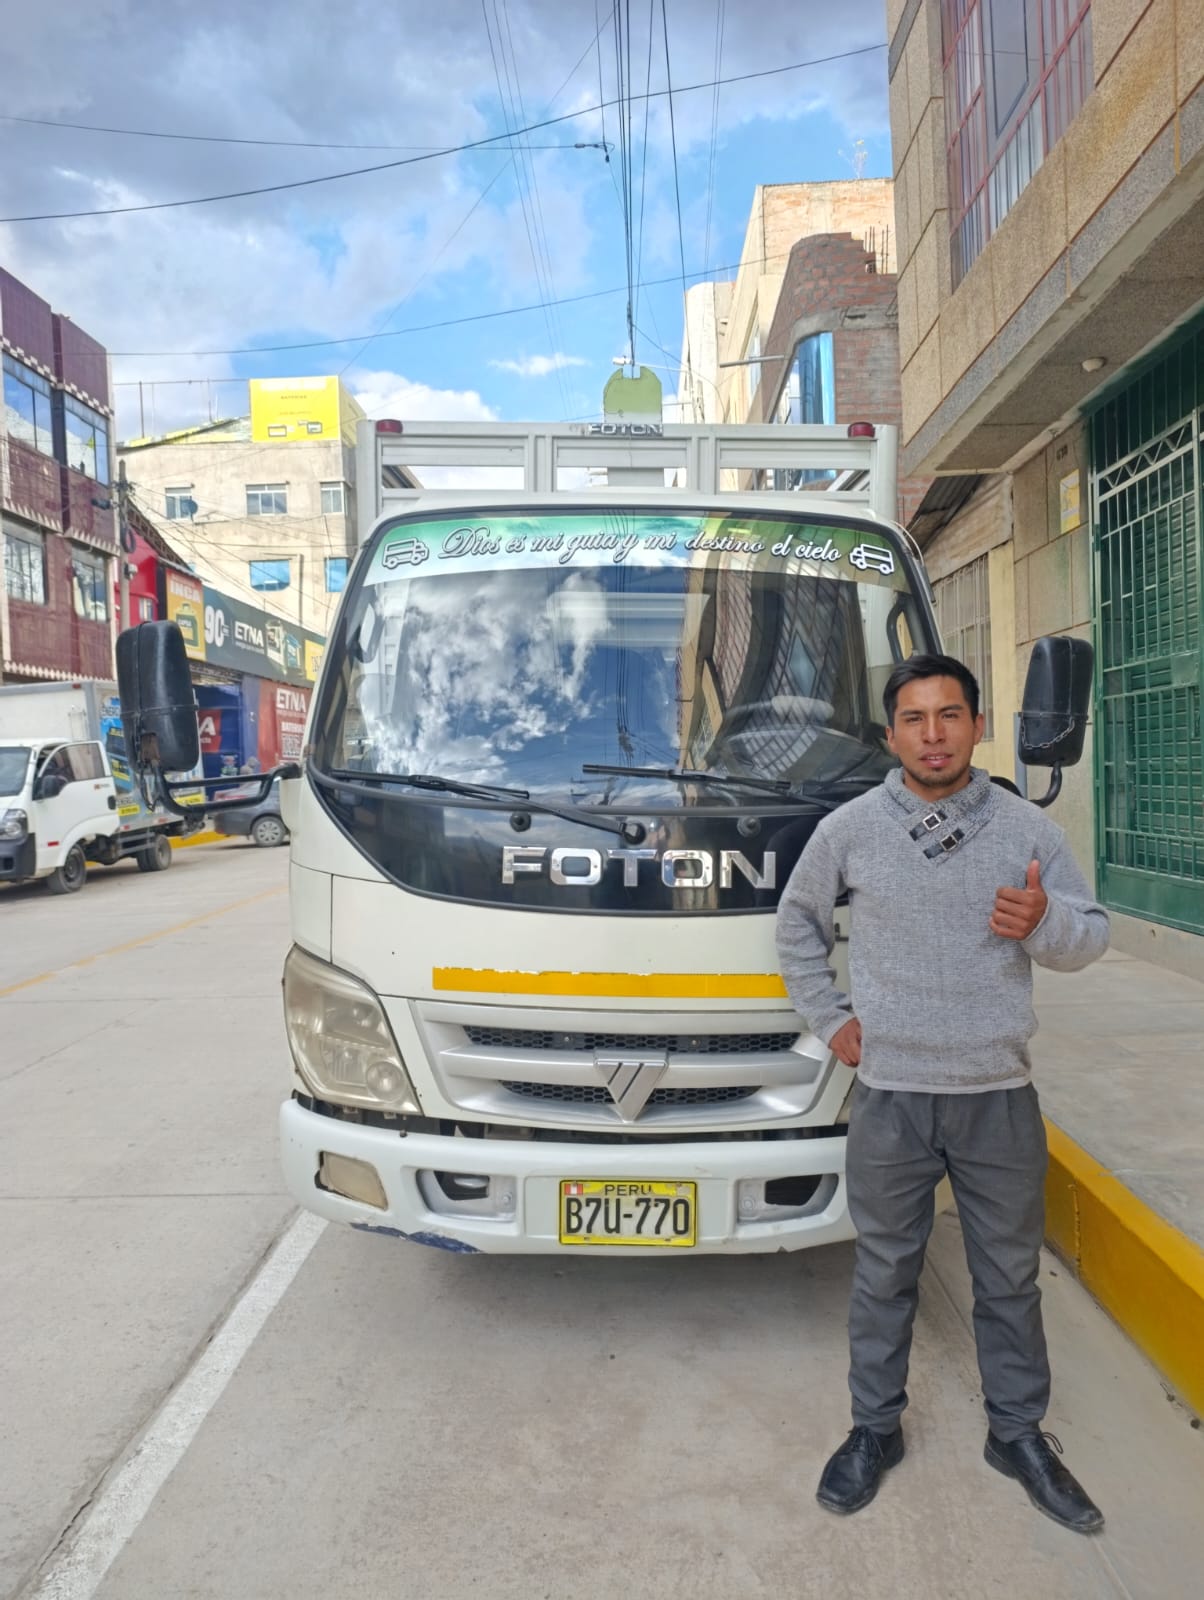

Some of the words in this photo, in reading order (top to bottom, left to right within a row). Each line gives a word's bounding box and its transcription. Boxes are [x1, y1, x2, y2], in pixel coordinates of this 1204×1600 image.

[587, 423, 663, 436] FOTON
[438, 526, 501, 559] Dios
[505, 535, 526, 554] es
[530, 532, 563, 552] mi
[613, 533, 639, 563] y
[645, 532, 677, 551] mi
[683, 531, 765, 554] destino
[771, 534, 792, 558] el
[794, 539, 842, 562] cielo
[204, 604, 225, 648] 90
[234, 620, 265, 648] ETNA
[275, 687, 307, 713] ETNA
[502, 845, 776, 889] FOTON
[604, 1184, 653, 1196] PERU
[566, 1197, 690, 1235] B7U-770
